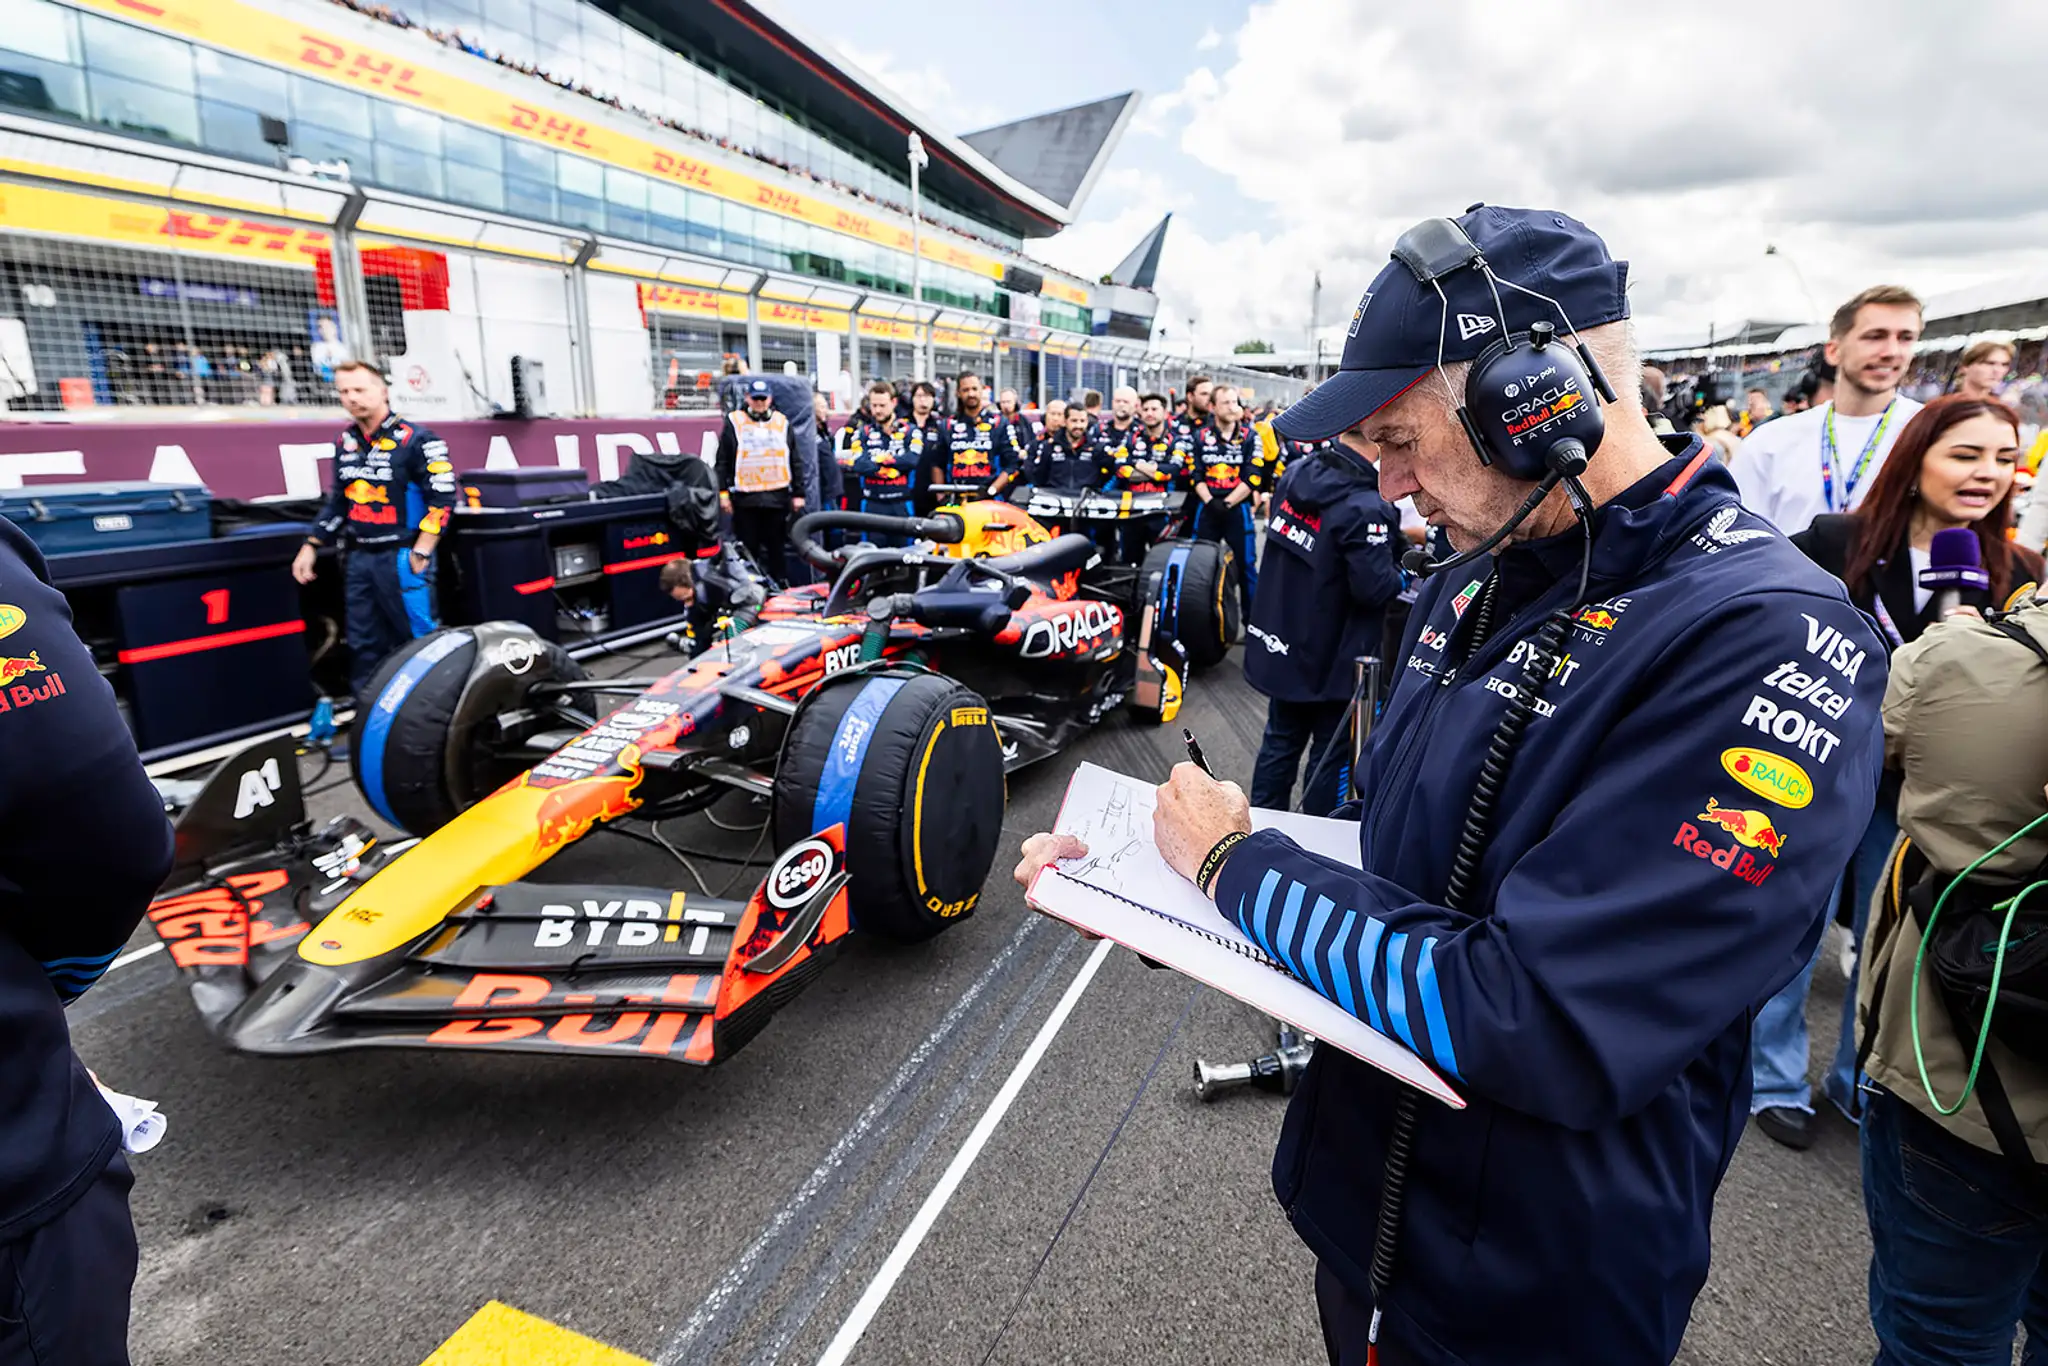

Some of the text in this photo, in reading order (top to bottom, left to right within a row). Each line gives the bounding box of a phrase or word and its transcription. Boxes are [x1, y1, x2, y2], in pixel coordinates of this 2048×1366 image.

[300, 35, 423, 98] DHL
[510, 103, 592, 150] DHL
[652, 151, 712, 187] DHL
[756, 186, 803, 215] DHL
[1539, 365, 1556, 380] poly
[1501, 376, 1577, 423] ORACLE
[1506, 407, 1551, 435] Red Bull
[1512, 402, 1589, 446] RACING
[1270, 515, 1306, 546] Mobil
[201, 589, 230, 624] 1
[1020, 600, 1121, 658] ORACLE
[1801, 613, 1867, 685] VISA
[11, 673, 66, 708] Bull
[1763, 660, 1854, 721] telcel
[838, 715, 858, 750] Left
[845, 719, 871, 764] Front
[1741, 694, 1841, 765] ROKT
[234, 757, 282, 819] A1
[1751, 761, 1807, 801] RAUCH
[1673, 821, 1775, 887] Red Bull
[533, 891, 725, 955] BYBIT
[926, 893, 979, 917] ZERO
